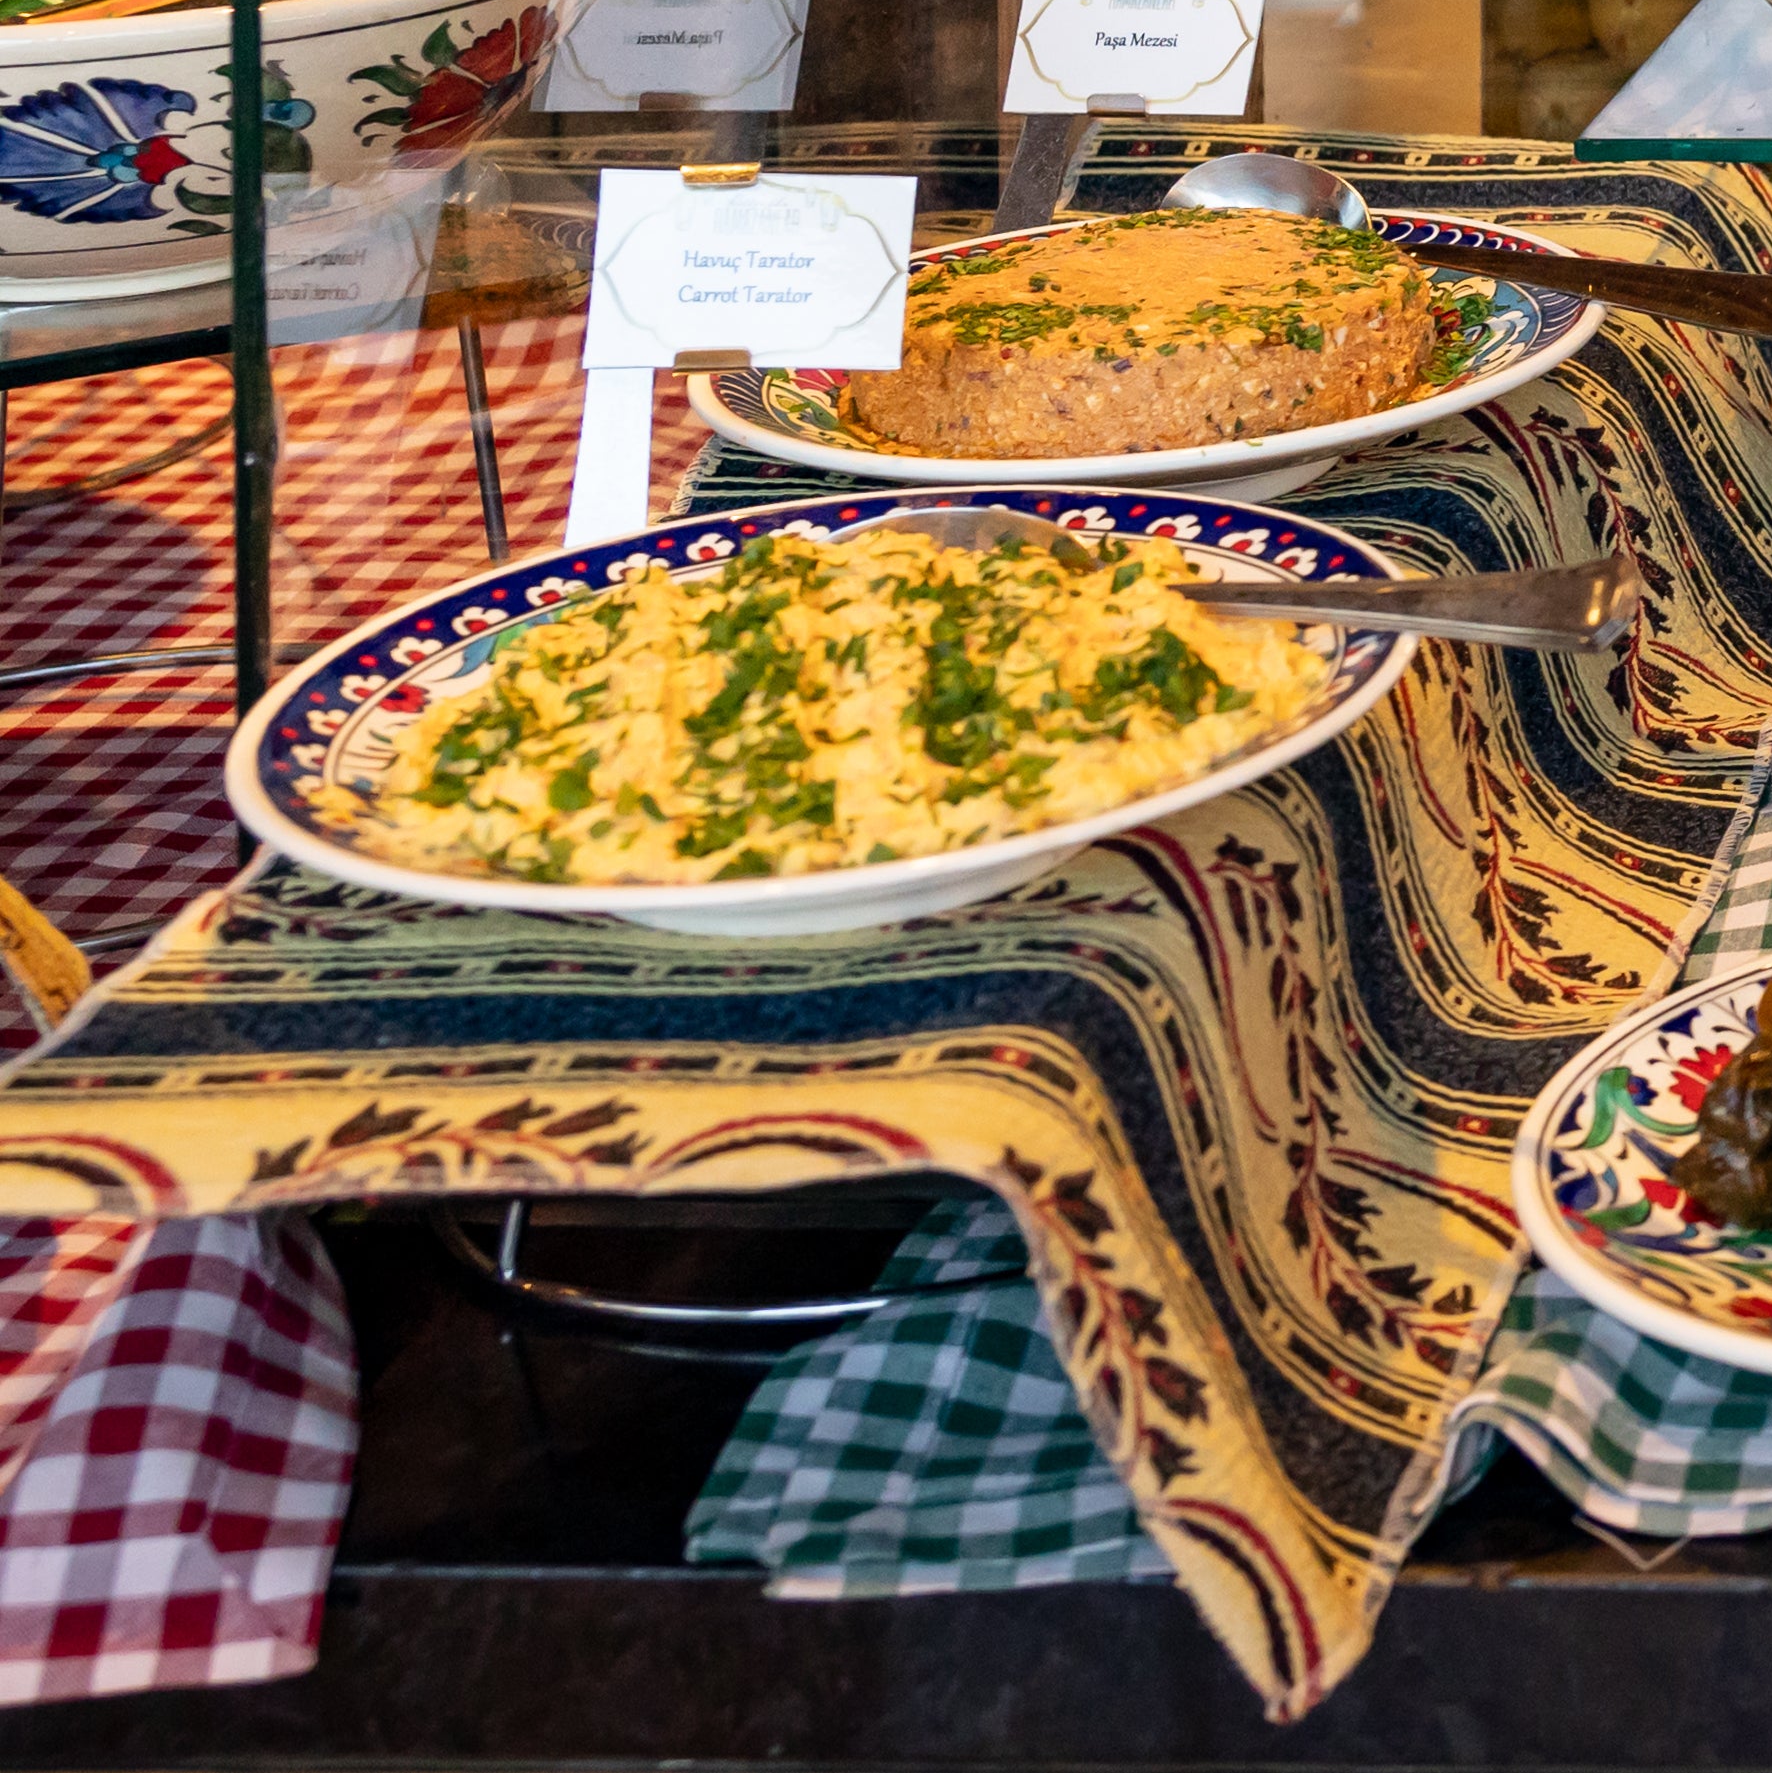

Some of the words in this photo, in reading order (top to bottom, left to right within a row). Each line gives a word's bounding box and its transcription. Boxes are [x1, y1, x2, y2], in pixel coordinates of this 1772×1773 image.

[1095, 32, 1127, 50] Paşa
[1130, 32, 1178, 48] Mezesi
[683, 250, 742, 273] Havuç
[746, 251, 815, 269] Tarator
[678, 284, 738, 303] Carrot
[743, 285, 813, 303] Tarator
